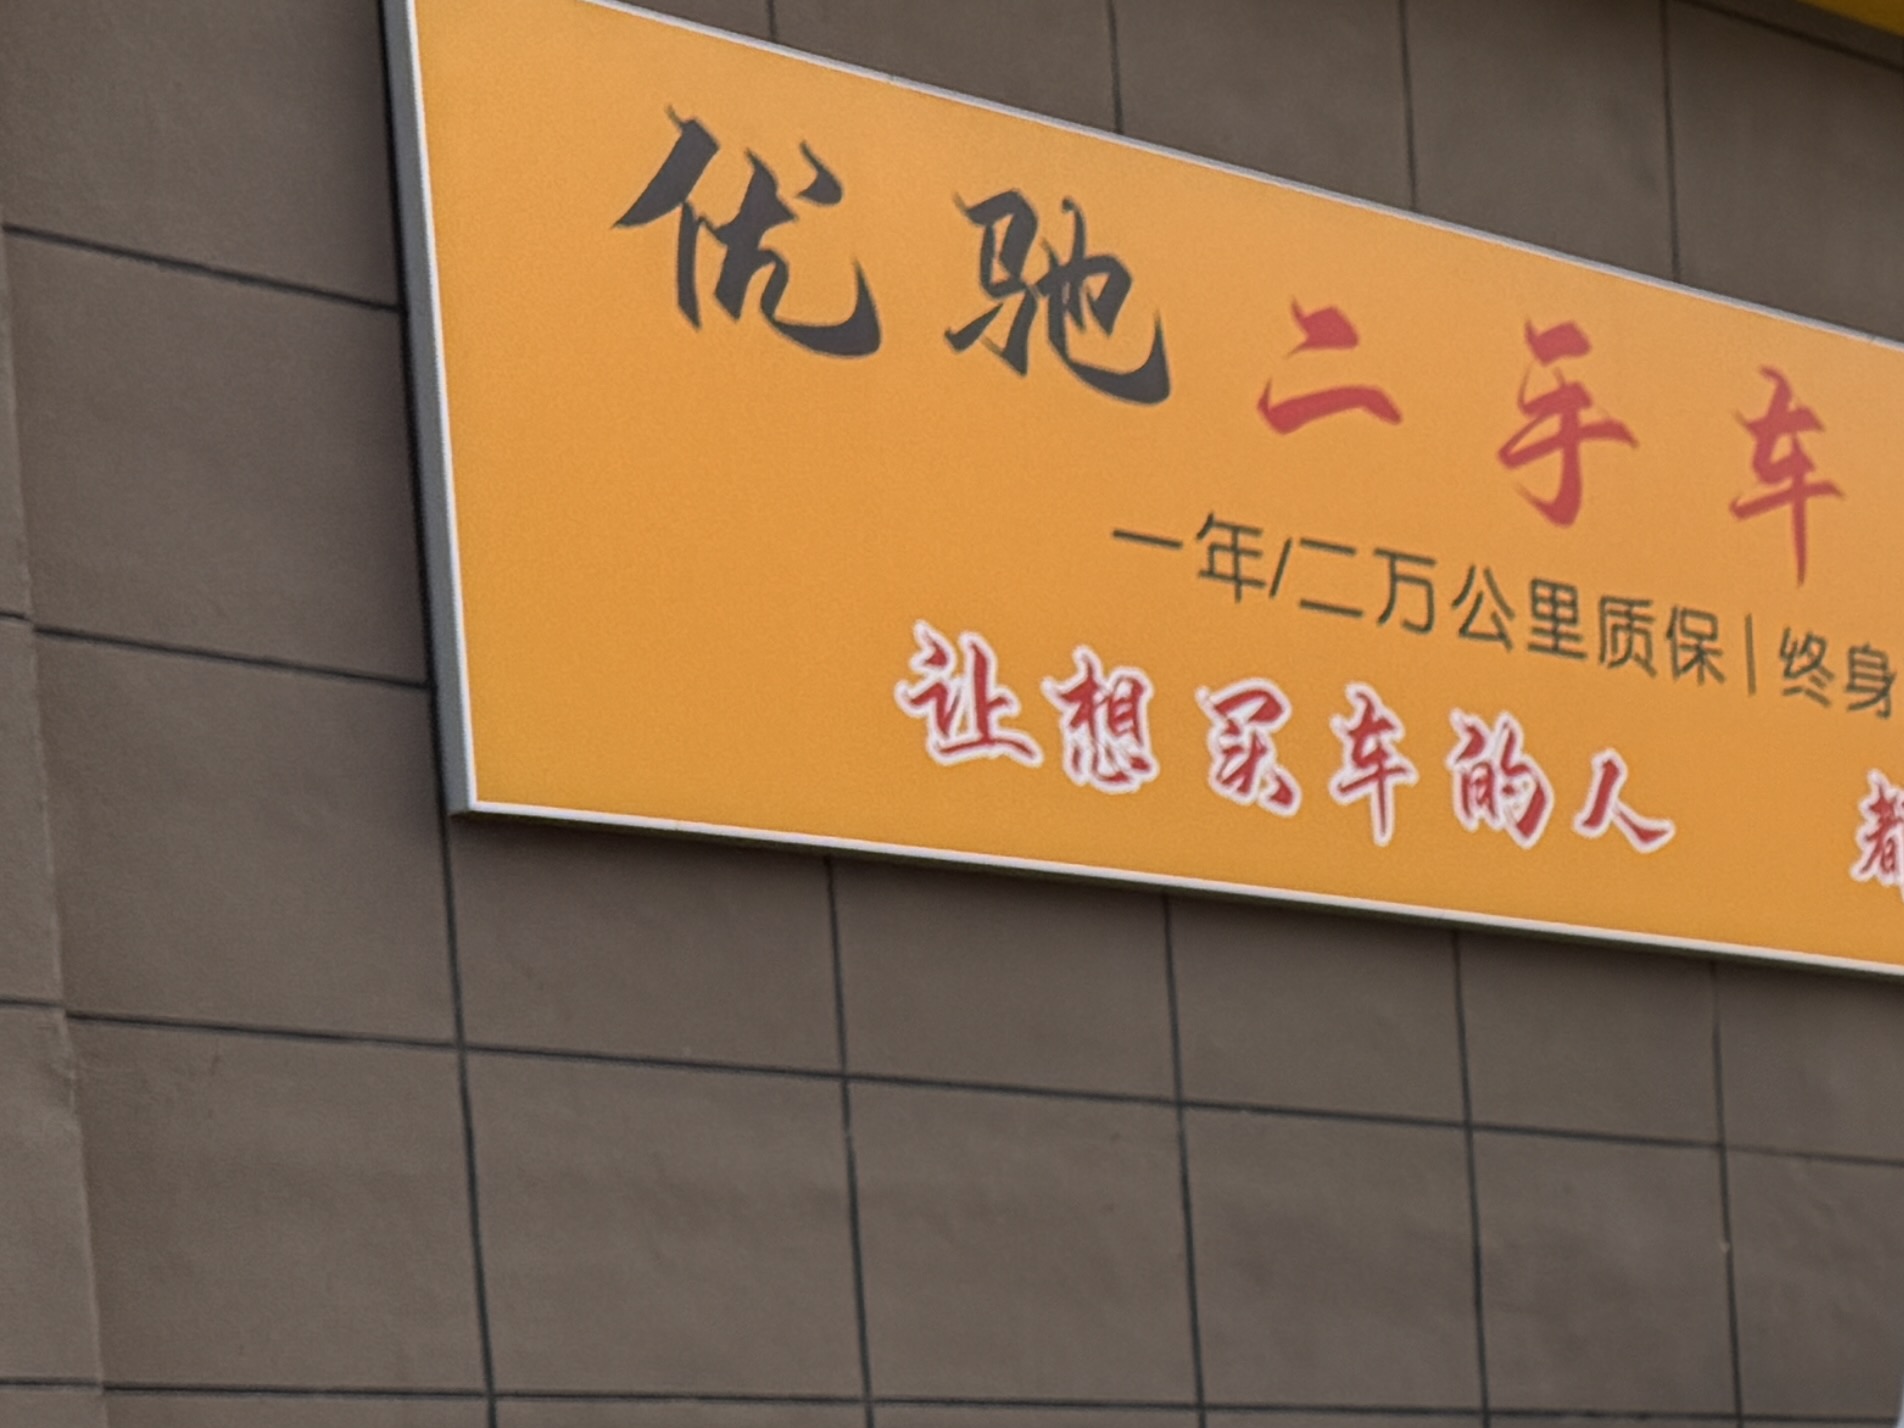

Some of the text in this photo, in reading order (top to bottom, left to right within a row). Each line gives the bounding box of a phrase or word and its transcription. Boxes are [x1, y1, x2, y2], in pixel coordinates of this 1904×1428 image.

[612, 108, 1844, 586] 优驰二手车
[895, 622, 1675, 846] 让想买车的人
